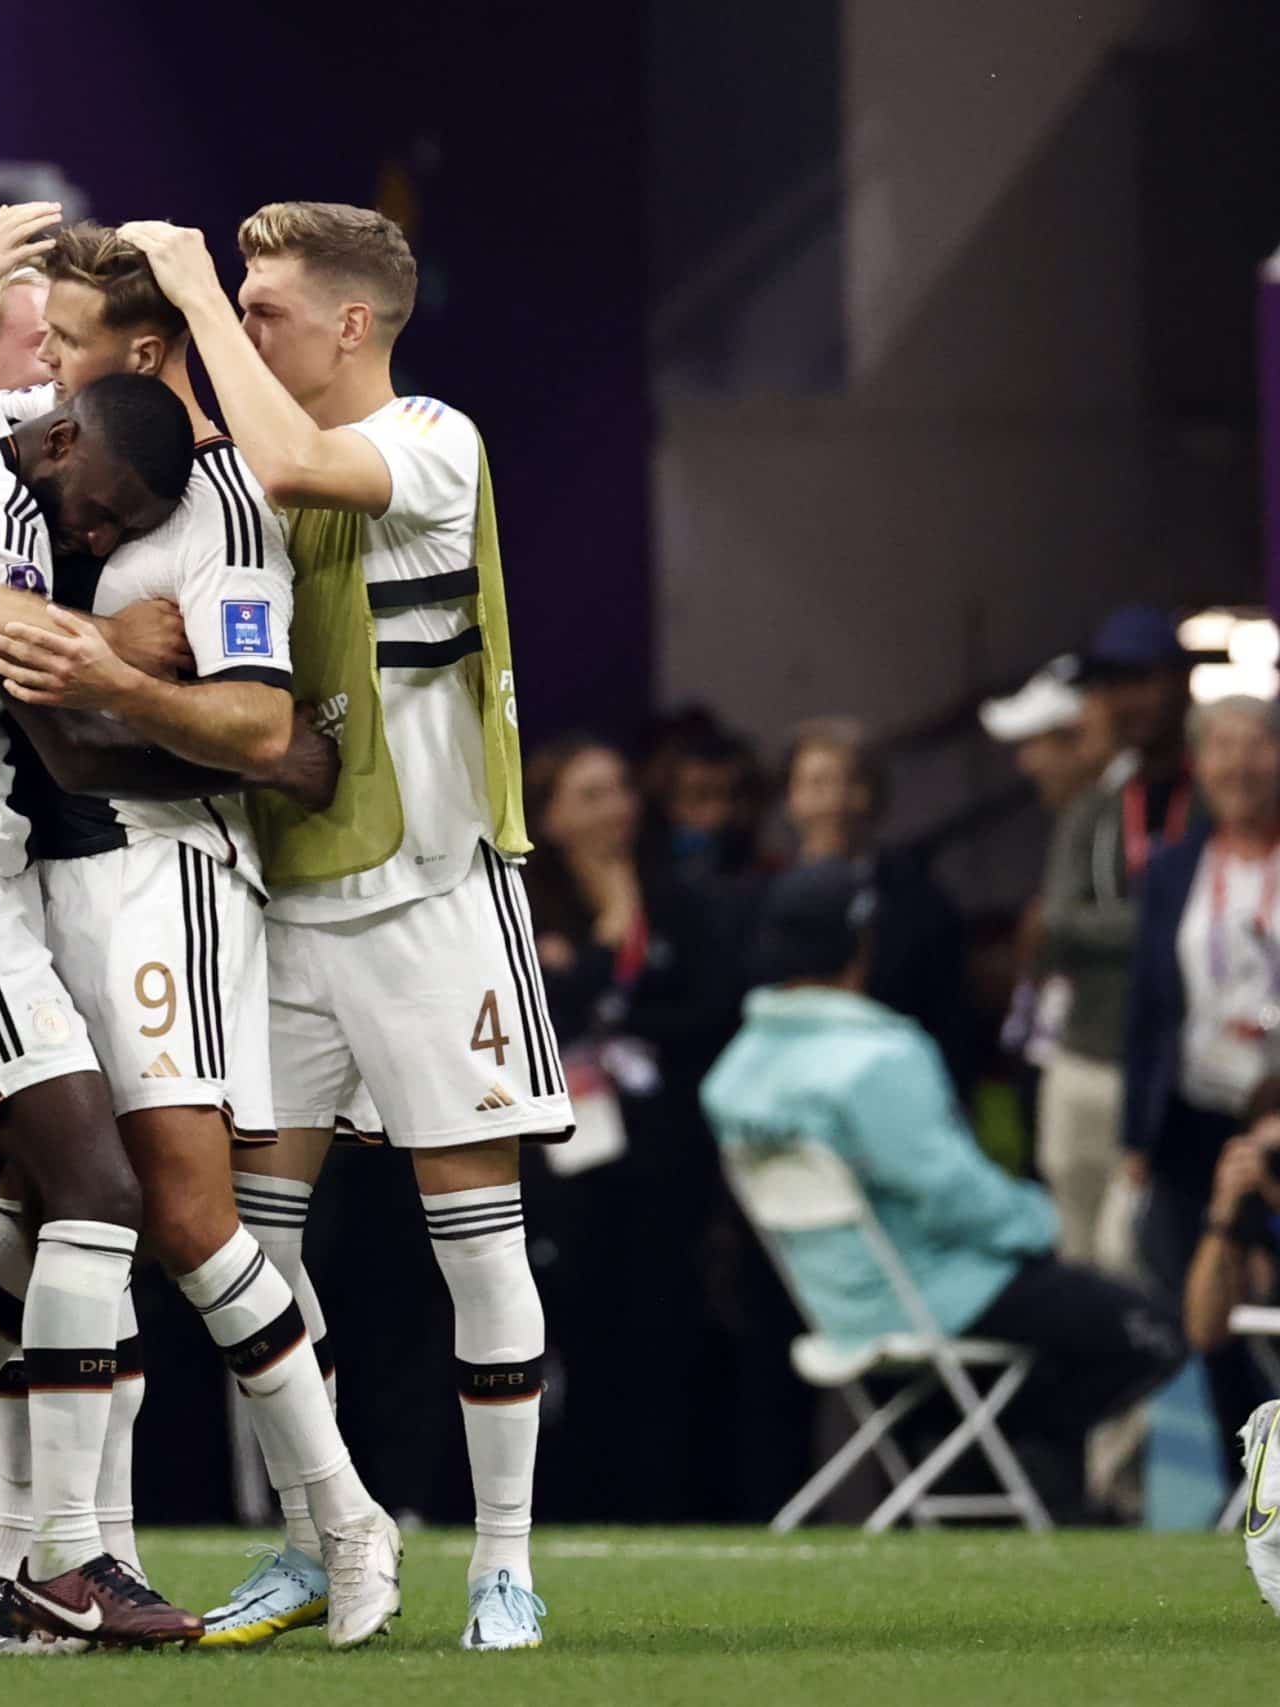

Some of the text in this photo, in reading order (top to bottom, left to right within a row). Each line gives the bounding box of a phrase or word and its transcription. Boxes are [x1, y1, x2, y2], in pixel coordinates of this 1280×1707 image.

[316, 692, 348, 726] UP
[134, 961, 176, 1038] 9
[470, 990, 509, 1066] 4
[473, 1372, 525, 1387] DFB
